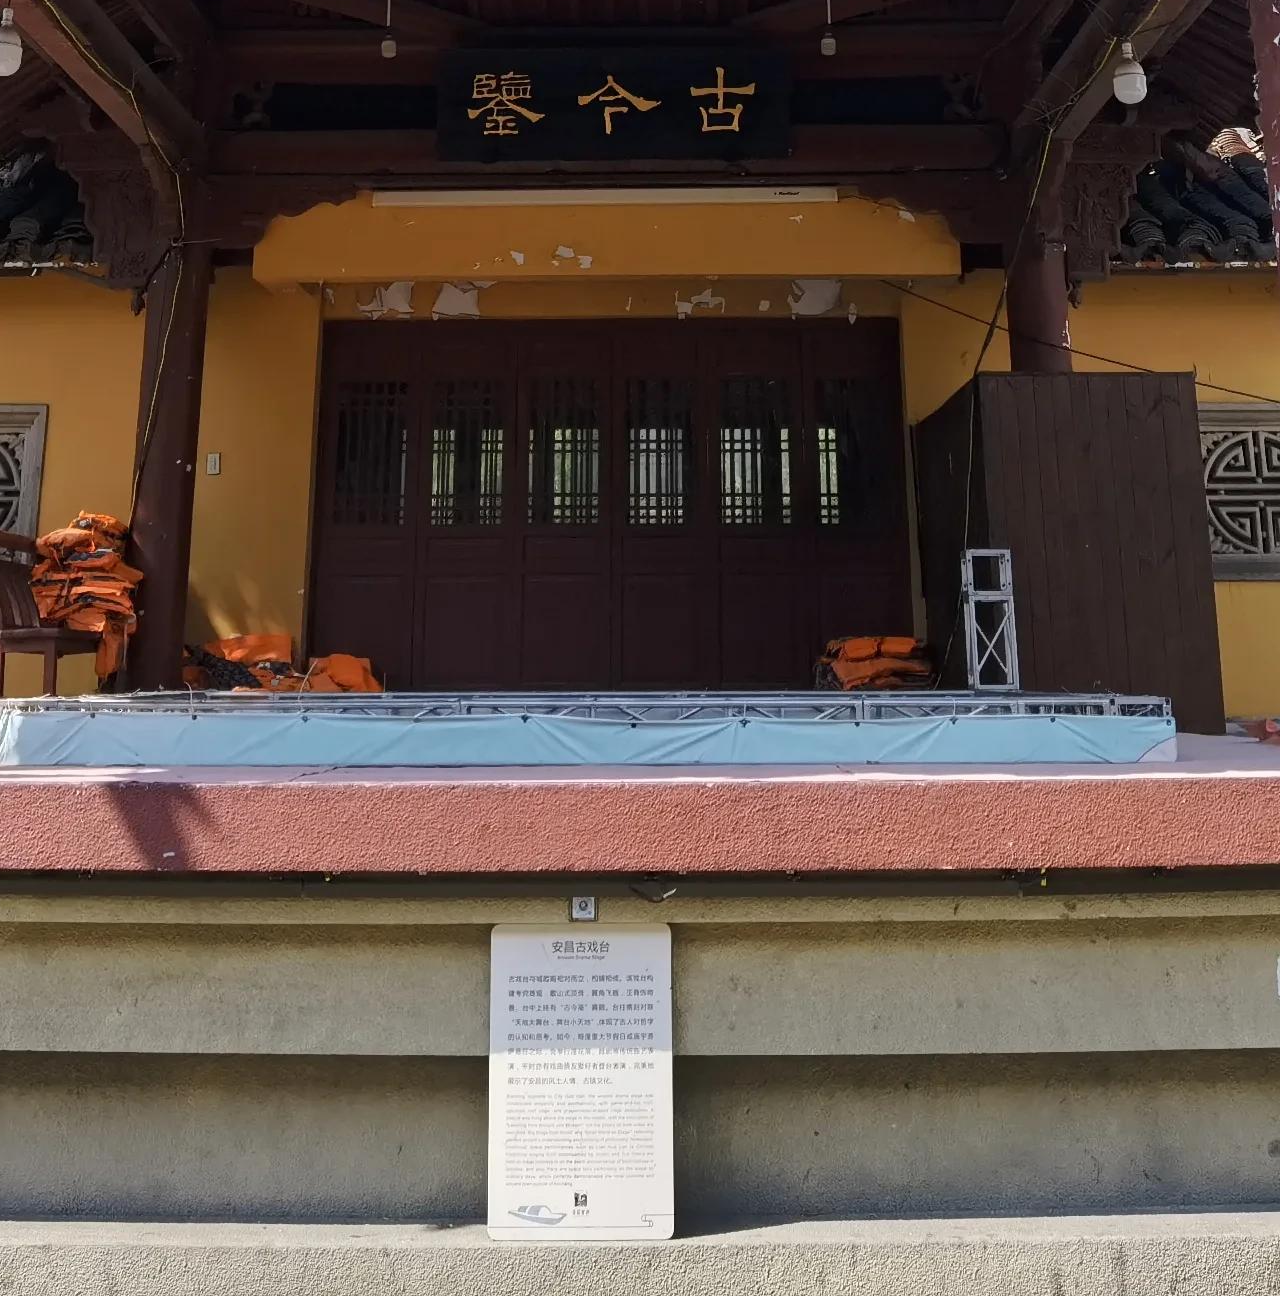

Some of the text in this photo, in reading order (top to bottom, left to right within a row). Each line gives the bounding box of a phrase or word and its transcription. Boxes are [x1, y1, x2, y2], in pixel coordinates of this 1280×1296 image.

[551, 940, 610, 954] 安昌古戏台
